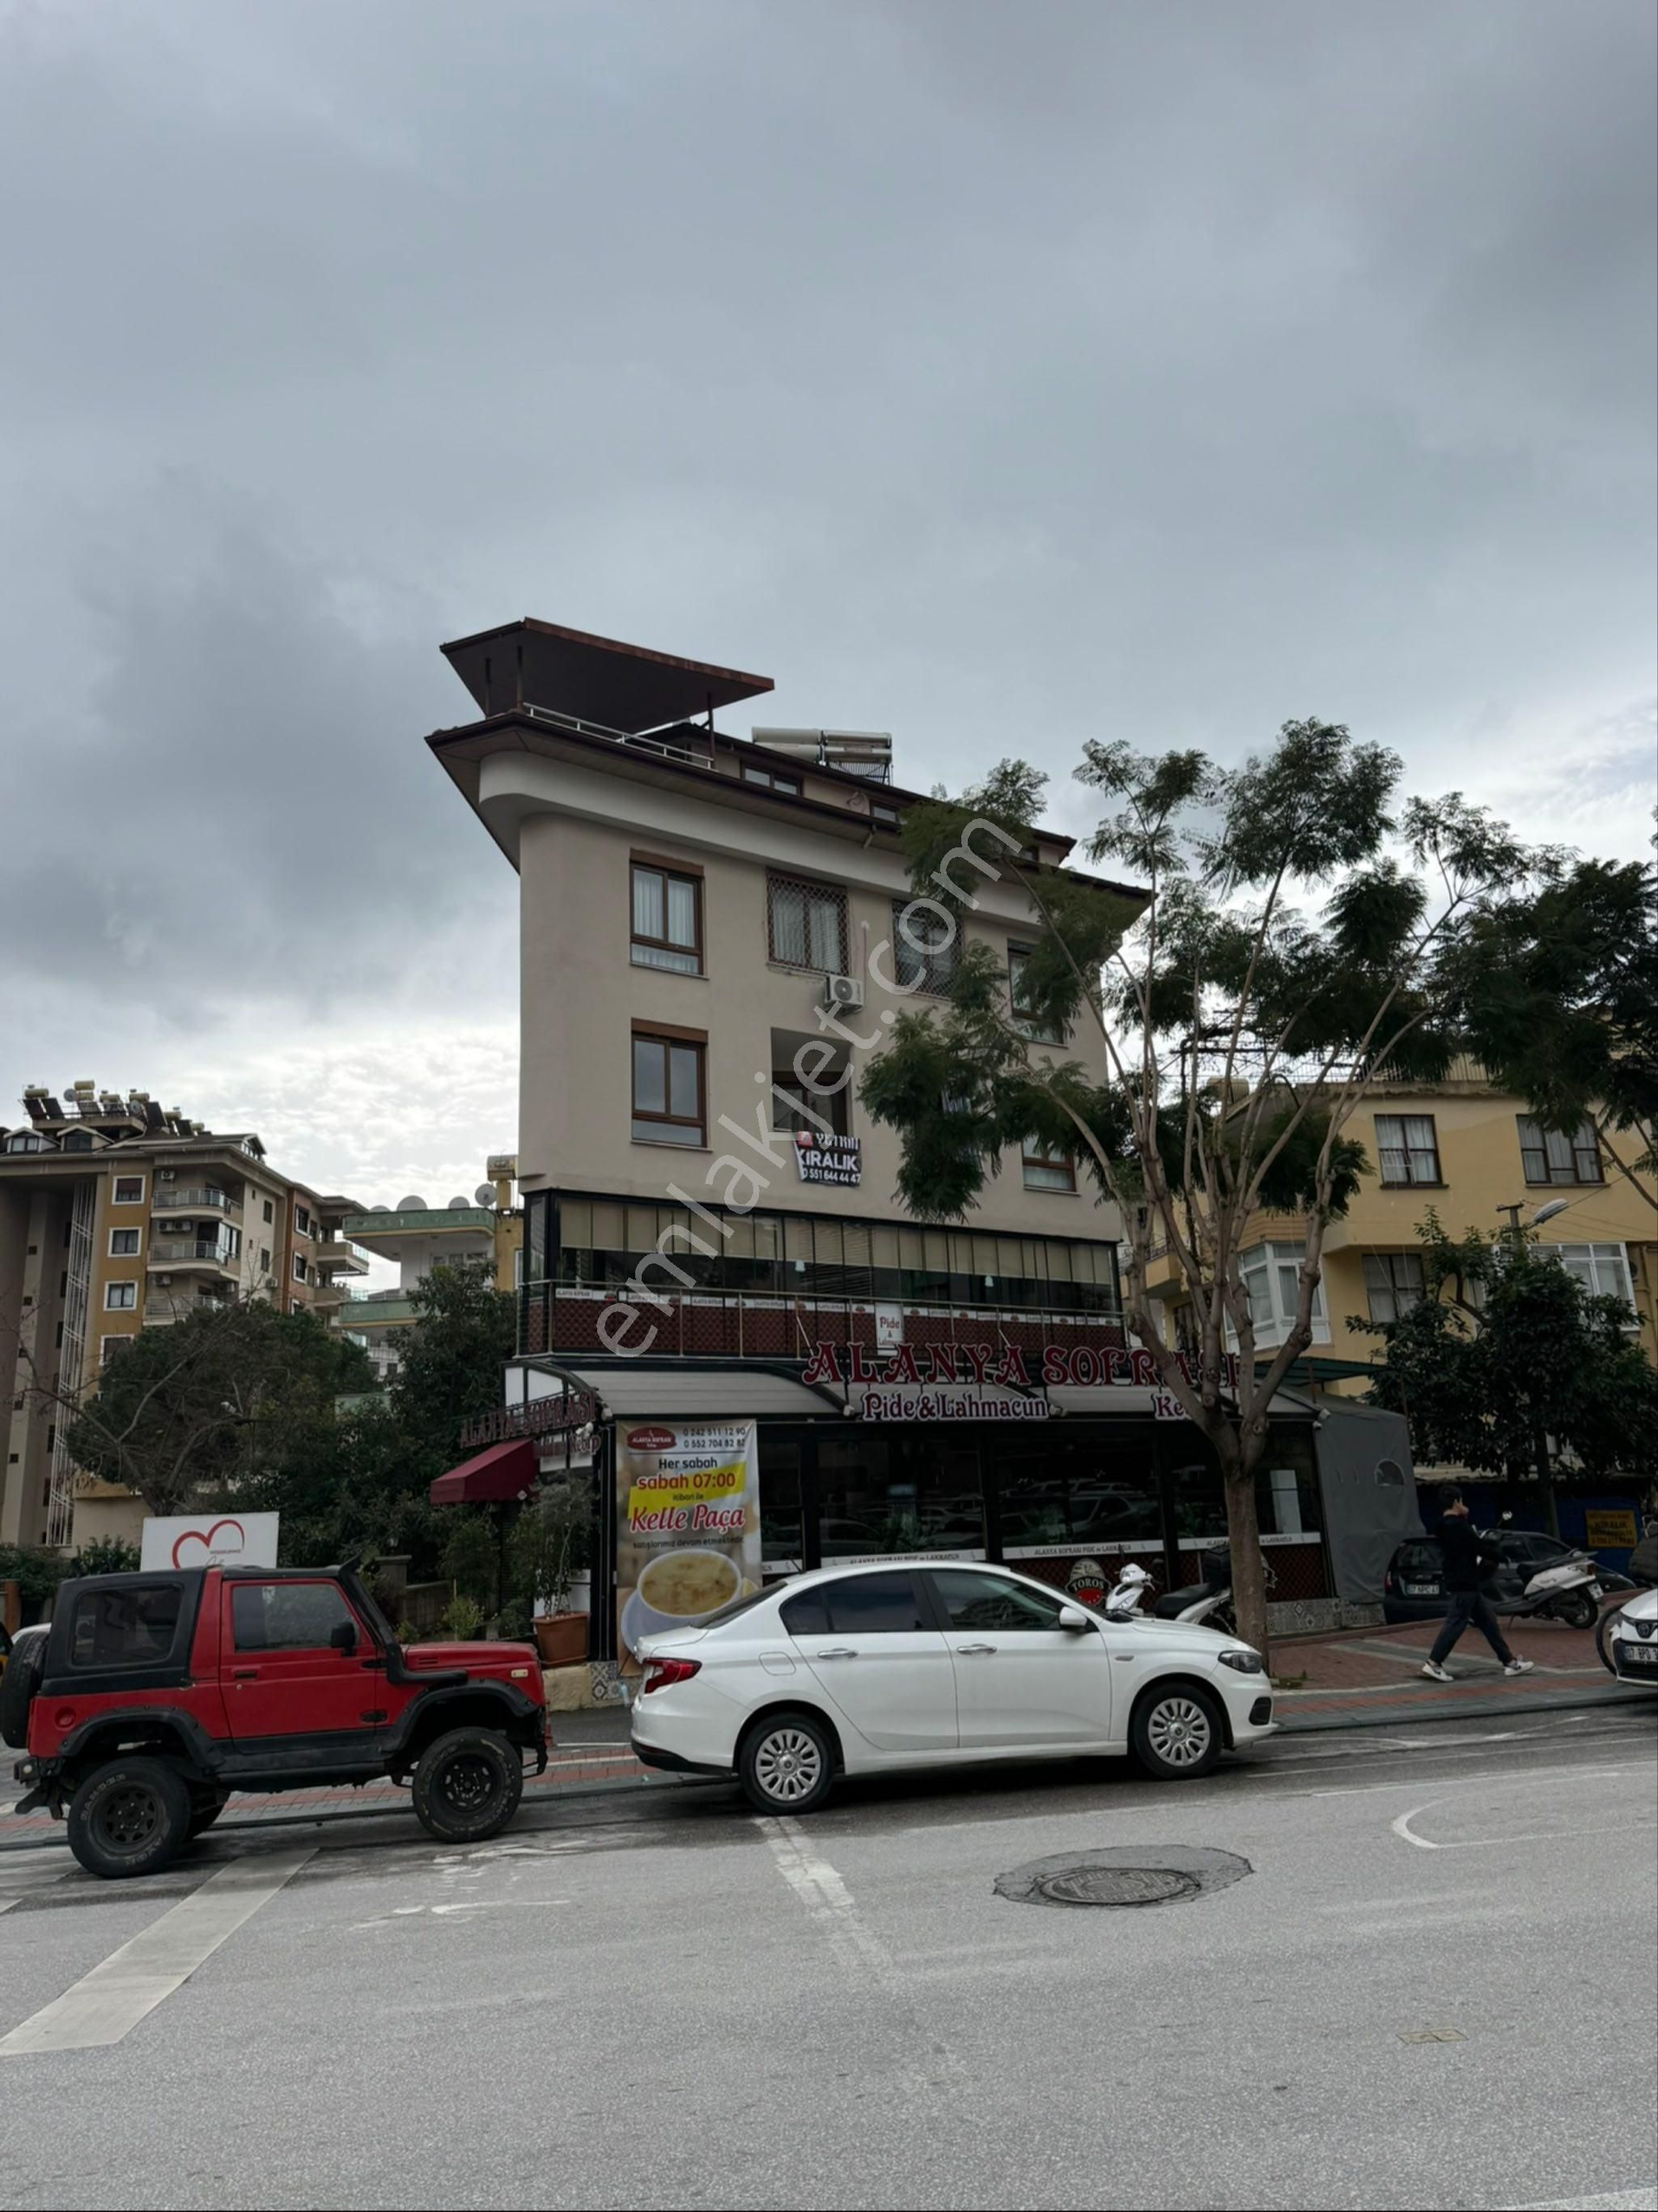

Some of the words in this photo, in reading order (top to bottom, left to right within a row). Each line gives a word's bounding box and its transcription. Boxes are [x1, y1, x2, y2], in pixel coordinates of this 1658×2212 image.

[809, 1168, 823, 1179] 551
[824, 1170, 838, 1182] 644
[839, 1172, 850, 1183] 44
[850, 1173, 862, 1183] 47
[880, 1316, 900, 1329] Pide
[802, 1341, 1032, 1386] ALANYA
[522, 1389, 596, 1435] SOFRASI
[691, 1428, 706, 1436] 242
[708, 1428, 722, 1436] 511
[724, 1428, 734, 1436] 12
[736, 1427, 746, 1436] 90
[692, 1440, 706, 1448] 552
[708, 1440, 722, 1448] 704
[724, 1439, 734, 1447] 82
[659, 1458, 679, 1470] Her
[682, 1457, 718, 1469] sabah
[637, 1472, 689, 1490] sabah
[693, 1472, 736, 1489] 07:00
[630, 1506, 688, 1532] Kelle
[692, 1504, 745, 1535] Paça
[676, 1539, 702, 1548] devam
[1071, 1579, 1105, 1591] TOROS
